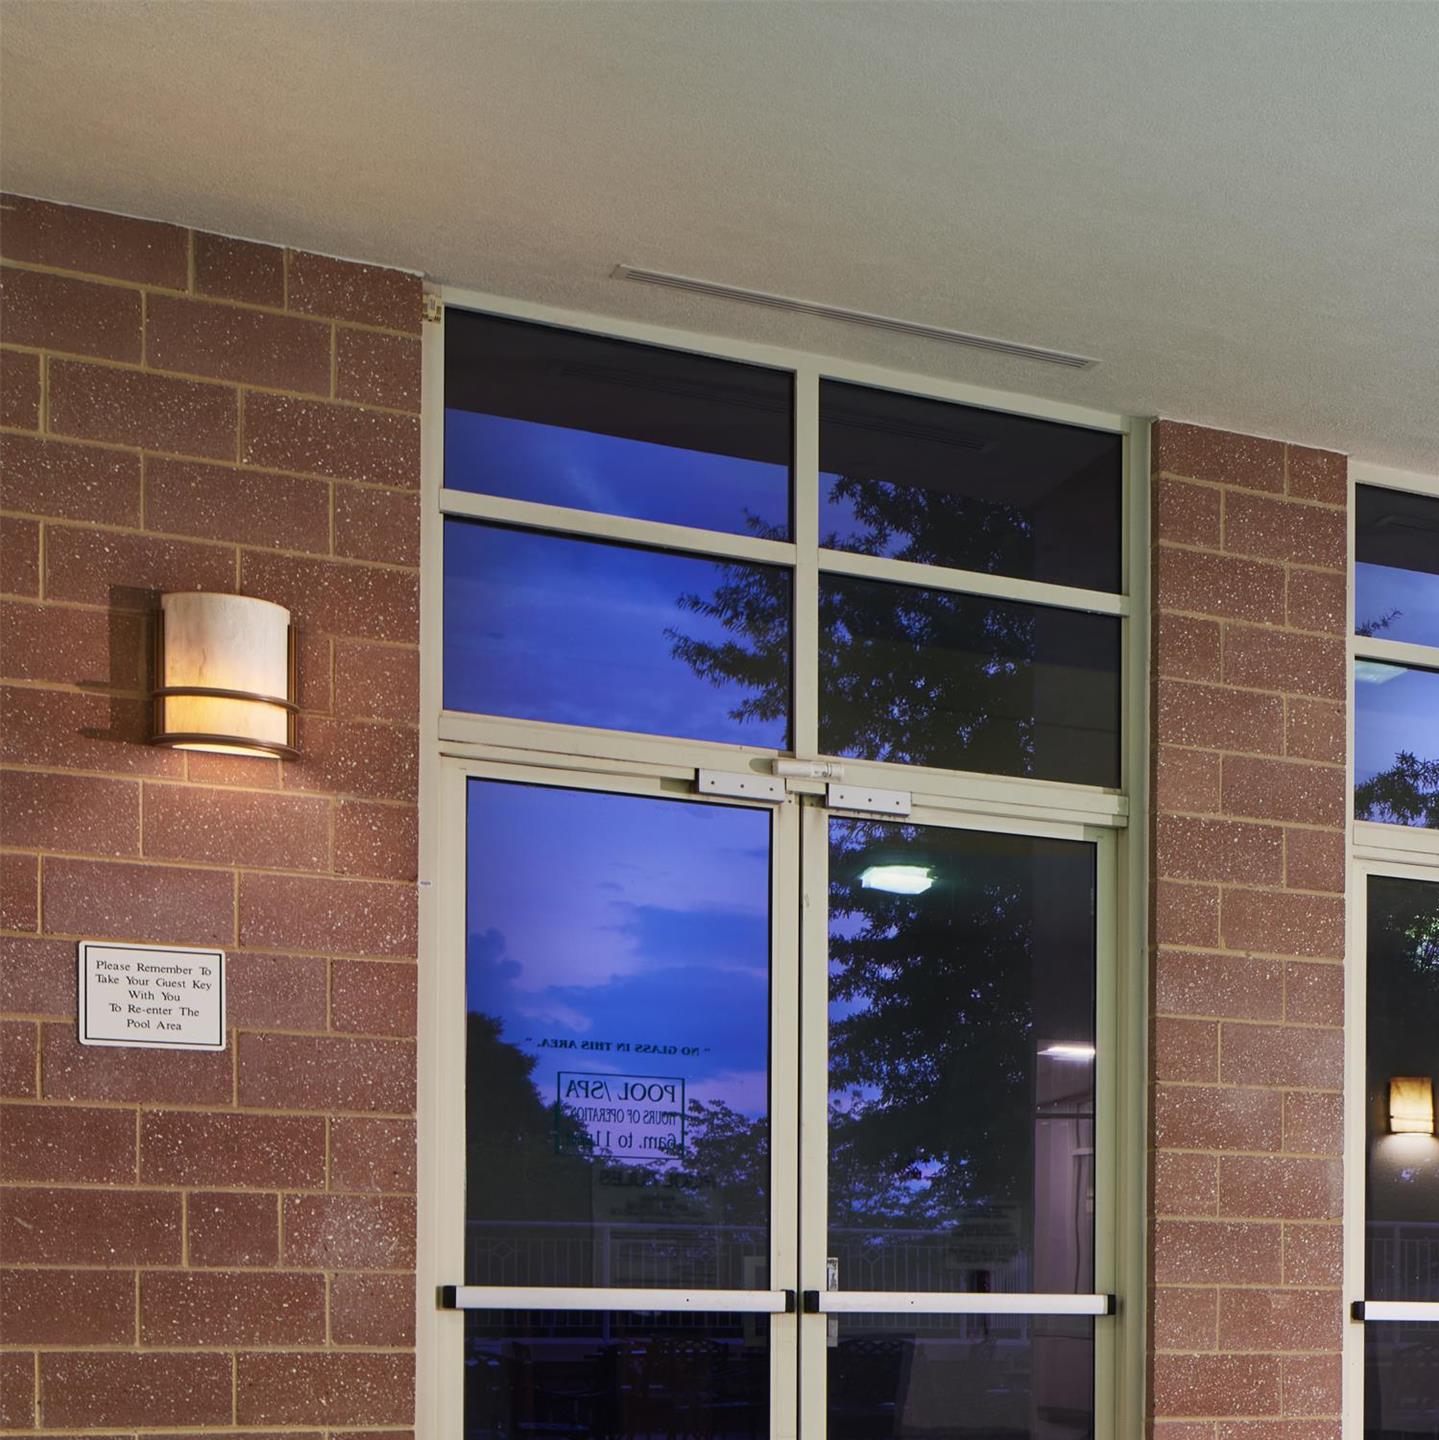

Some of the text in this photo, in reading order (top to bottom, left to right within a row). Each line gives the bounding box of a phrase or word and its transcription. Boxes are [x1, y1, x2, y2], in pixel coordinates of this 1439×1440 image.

[96, 960, 212, 976] Please Remember To
[95, 974, 212, 991] Take Your Guest Key
[128, 990, 180, 1001] With You
[109, 1003, 199, 1017] To Re-enter The
[127, 1019, 182, 1031] Pool Area
